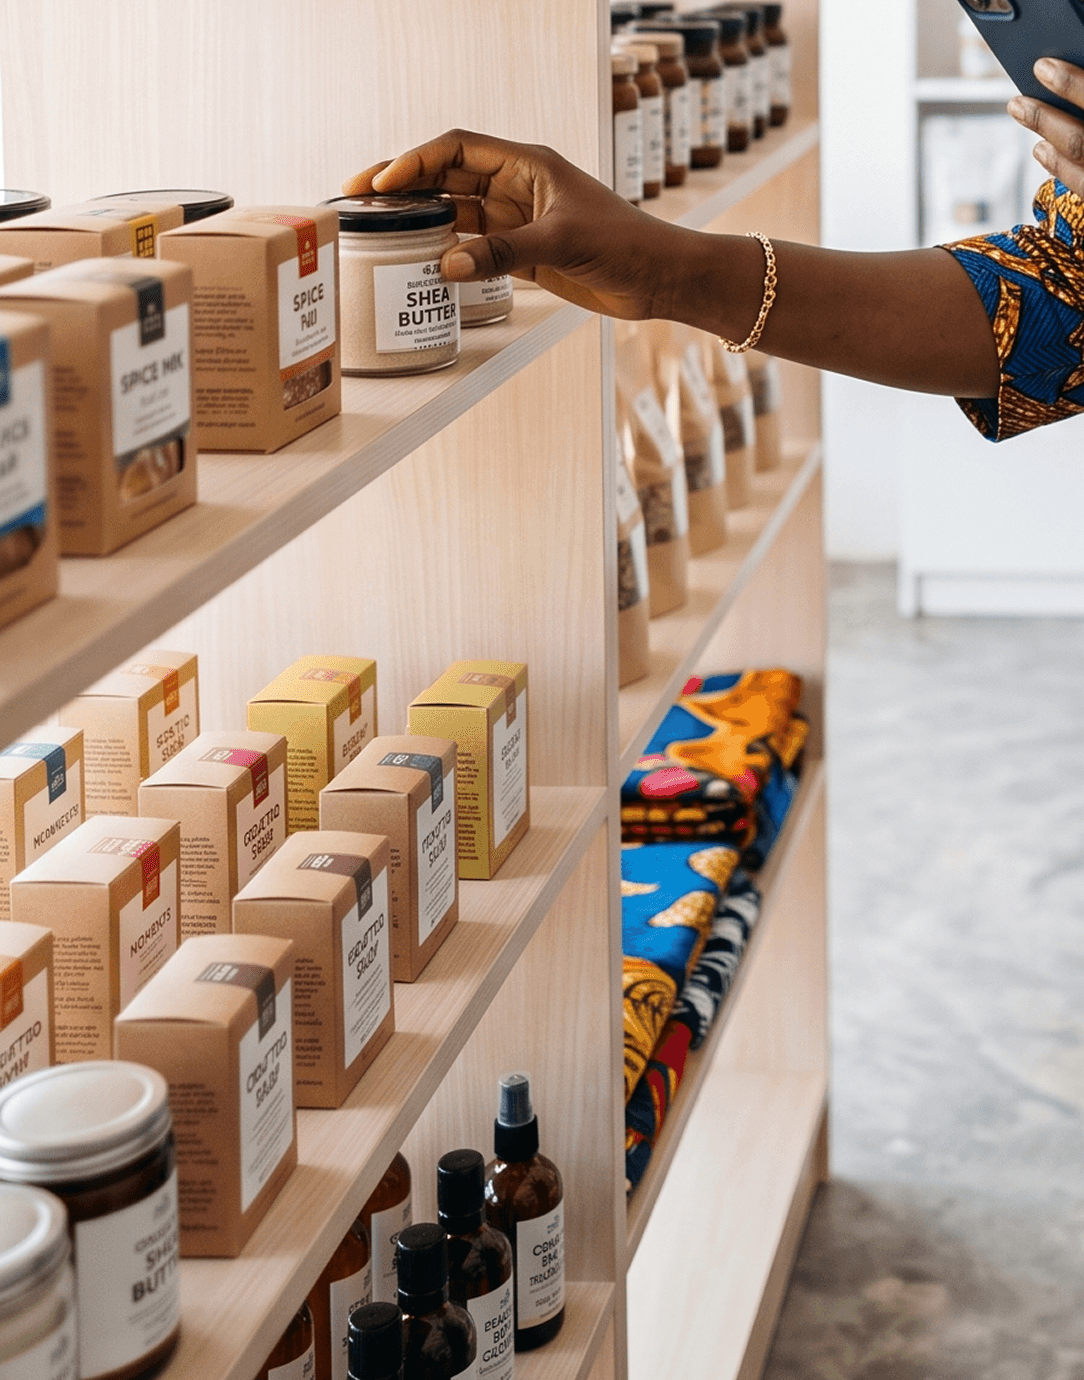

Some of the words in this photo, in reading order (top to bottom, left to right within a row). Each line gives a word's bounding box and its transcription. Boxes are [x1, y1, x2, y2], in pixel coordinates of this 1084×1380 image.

[293, 282, 324, 312] SPICE
[406, 286, 450, 308] SHEA
[398, 303, 456, 327] BUTTER
